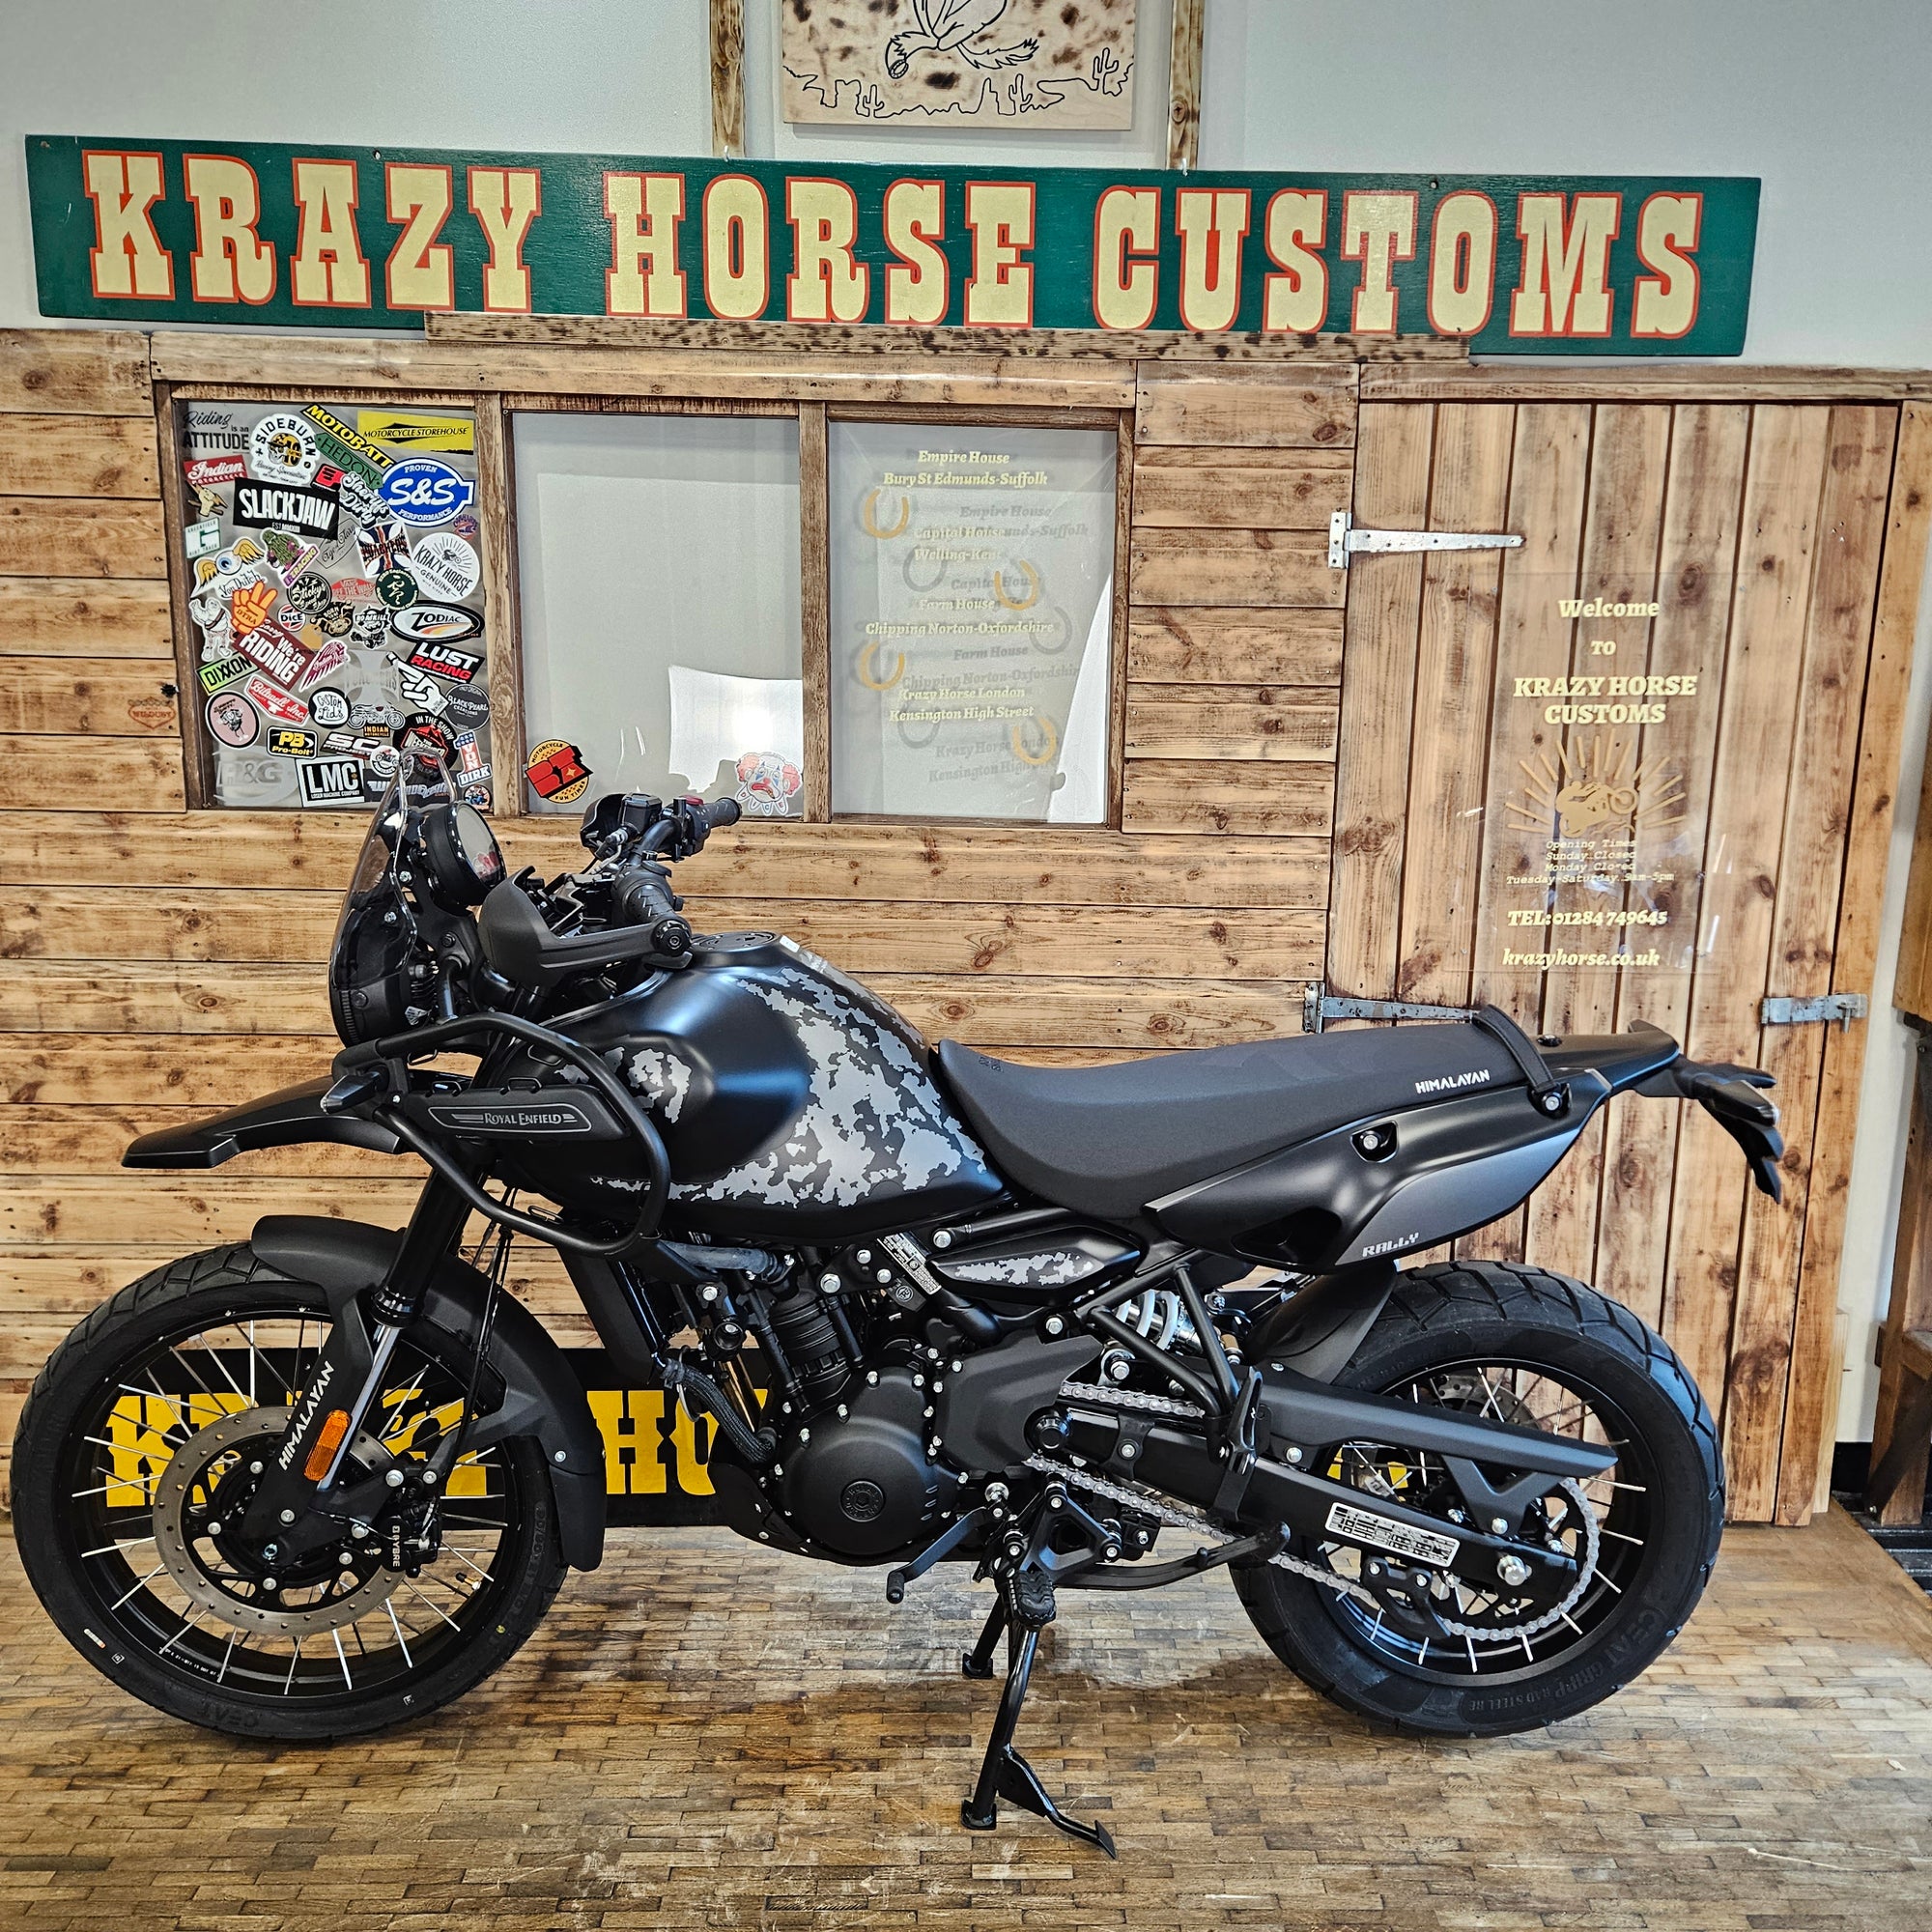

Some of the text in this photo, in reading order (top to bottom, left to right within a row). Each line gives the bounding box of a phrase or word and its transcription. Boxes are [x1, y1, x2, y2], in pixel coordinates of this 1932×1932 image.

[81, 149, 1704, 338] KRAZY HORSE CUSTOMS
[185, 411, 232, 429] Riding
[184, 432, 250, 449] ATTITUDE
[255, 417, 316, 457] SIDEBURN
[306, 405, 393, 468] MOTOBATT
[363, 427, 469, 438] MOTORCYCLE STOREHOUSE
[322, 439, 378, 485] HEDON
[918, 449, 1010, 467] Empire House
[188, 461, 242, 481] Indian
[404, 464, 437, 473] PROVEN
[884, 471, 1048, 489] Bury St Edmunds-Suffolk
[388, 478, 457, 505] S&S
[239, 488, 335, 530] SLACKJAW
[398, 507, 452, 522] PERFORMANCE
[914, 526, 964, 543] Capital
[965, 526, 1006, 539] House
[414, 545, 444, 578] KRAZY
[442, 568, 473, 597] HORSE
[420, 570, 452, 594] GENUINE
[919, 597, 995, 611] Farm House
[1558, 598, 1660, 618] Welcome
[412, 612, 464, 631] ZODIAC
[866, 621, 1055, 638] Chipping Norton-Oxfordshire
[240, 630, 299, 683] RIDING
[277, 637, 305, 666] We're
[415, 642, 479, 669] LUST
[1591, 640, 1616, 655] TO
[204, 654, 252, 686] DIXXON
[412, 656, 471, 680] RACING
[898, 687, 1026, 702] Krazy Horse London
[1514, 675, 1697, 697] KRAZY HORSE
[890, 705, 1035, 723] Kensington High Street
[1545, 703, 1666, 724] CUSTOMS
[425, 716, 438, 724] THE
[438, 721, 454, 740] SHOW
[279, 731, 305, 748] PB
[327, 733, 380, 750] SC
[271, 746, 311, 756] Pro-Bolt
[324, 745, 372, 756] PROJECT
[531, 742, 563, 763] MOTORCYCLE
[306, 762, 357, 794] LMC
[460, 766, 491, 784] DIRK
[571, 781, 585, 798] TIMES
[1546, 838, 1637, 850] Opening Times
[1546, 863, 1587, 872] Monday
[1502, 949, 1661, 971] krazyhorse.co.uk
[1414, 1068, 1491, 1094] HIMALAYAN
[485, 1113, 561, 1126] ROYAL ENFIELD
[1362, 1232, 1420, 1257] RALLY
[277, 1360, 334, 1471] HIMALAYAN
